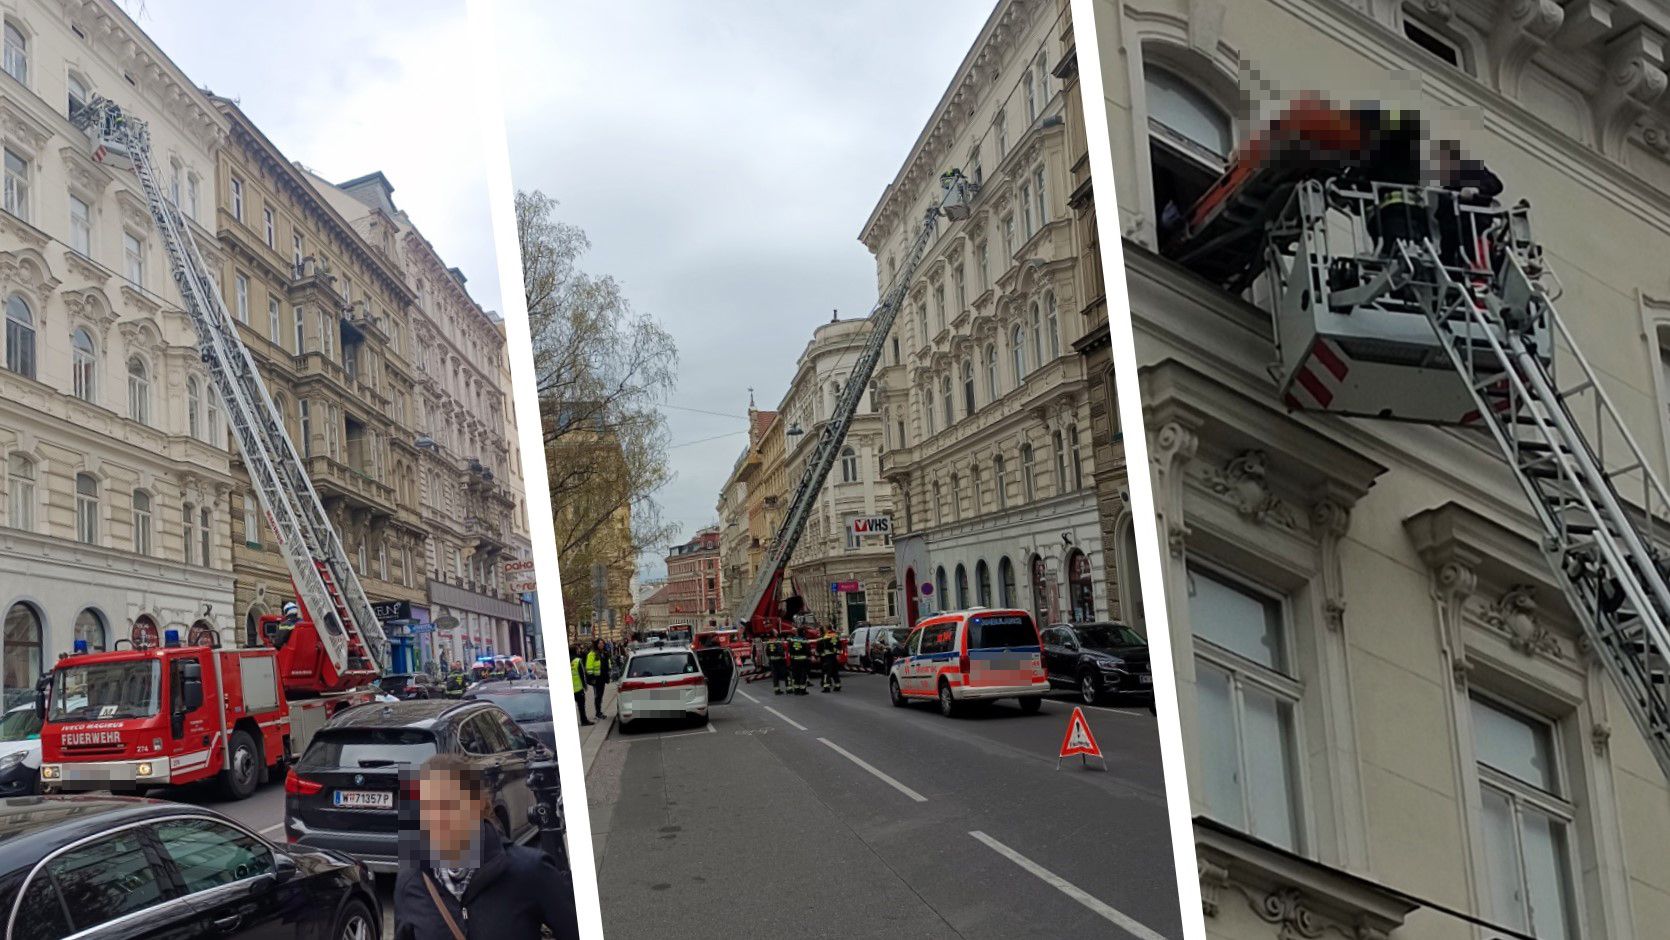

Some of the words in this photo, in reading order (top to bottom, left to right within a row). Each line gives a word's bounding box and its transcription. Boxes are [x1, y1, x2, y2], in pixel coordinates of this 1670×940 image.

[866, 518, 889, 532] VHS
[61, 724, 86, 732] IVECO
[86, 721, 124, 730] MAGIRUS
[61, 731, 121, 746] FEUERWEHR
[136, 745, 149, 753] 274
